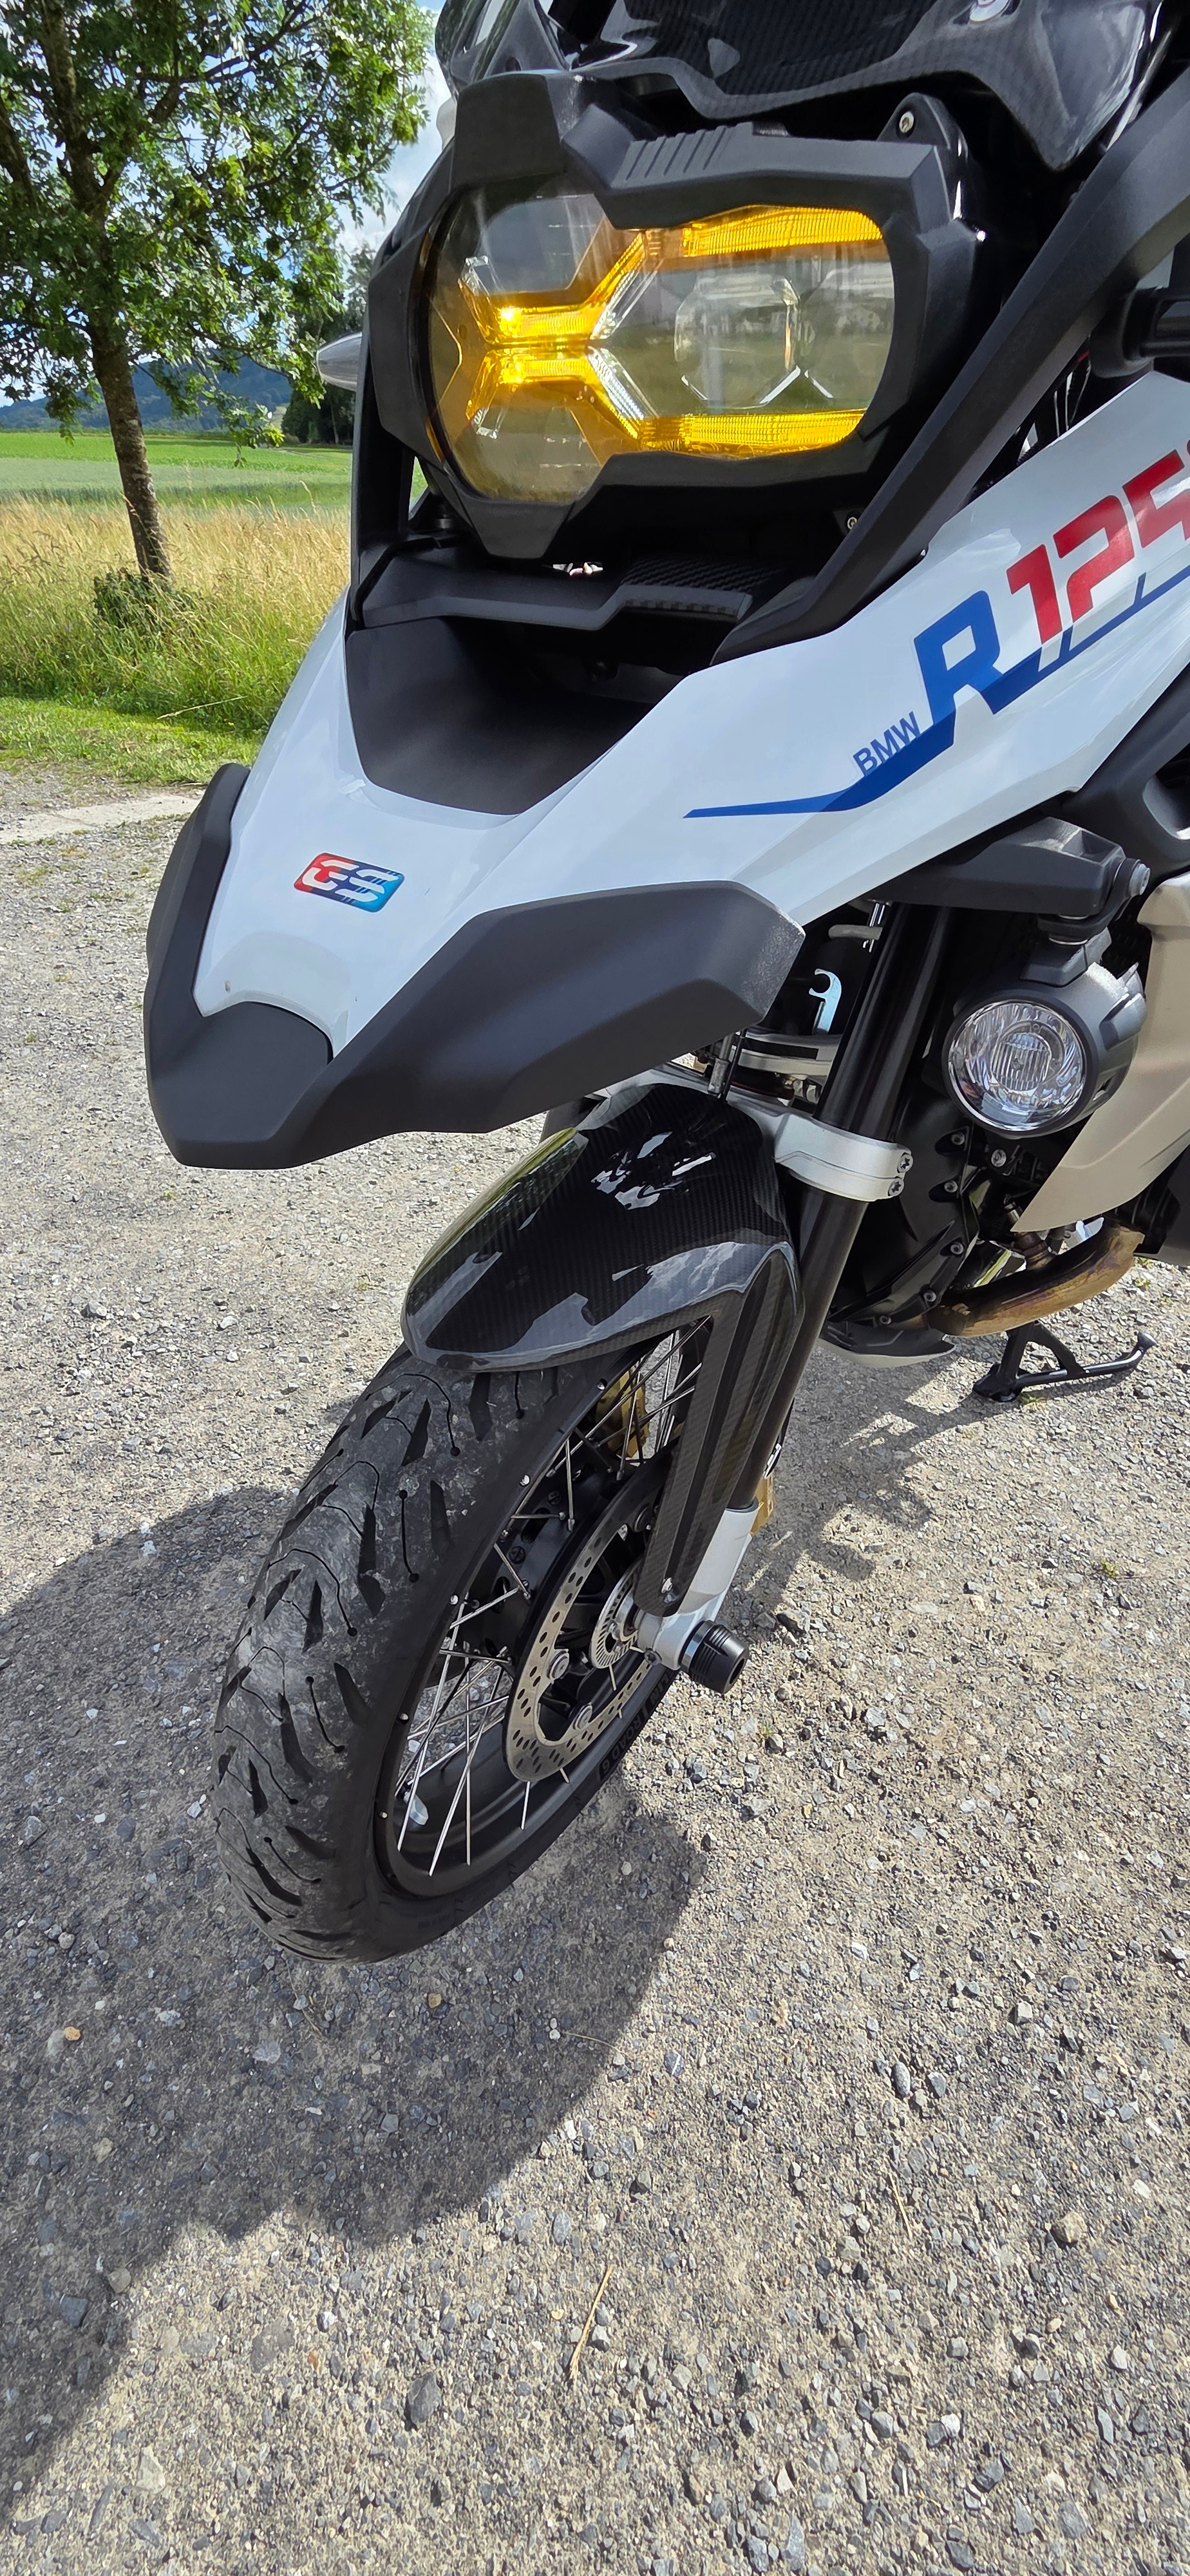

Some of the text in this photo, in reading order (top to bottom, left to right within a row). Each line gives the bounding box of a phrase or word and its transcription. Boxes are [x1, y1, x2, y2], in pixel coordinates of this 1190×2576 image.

[853, 439, 1190, 777] BMW R 125
[302, 859, 399, 902] GS
[612, 1714, 643, 1759] ROAD
